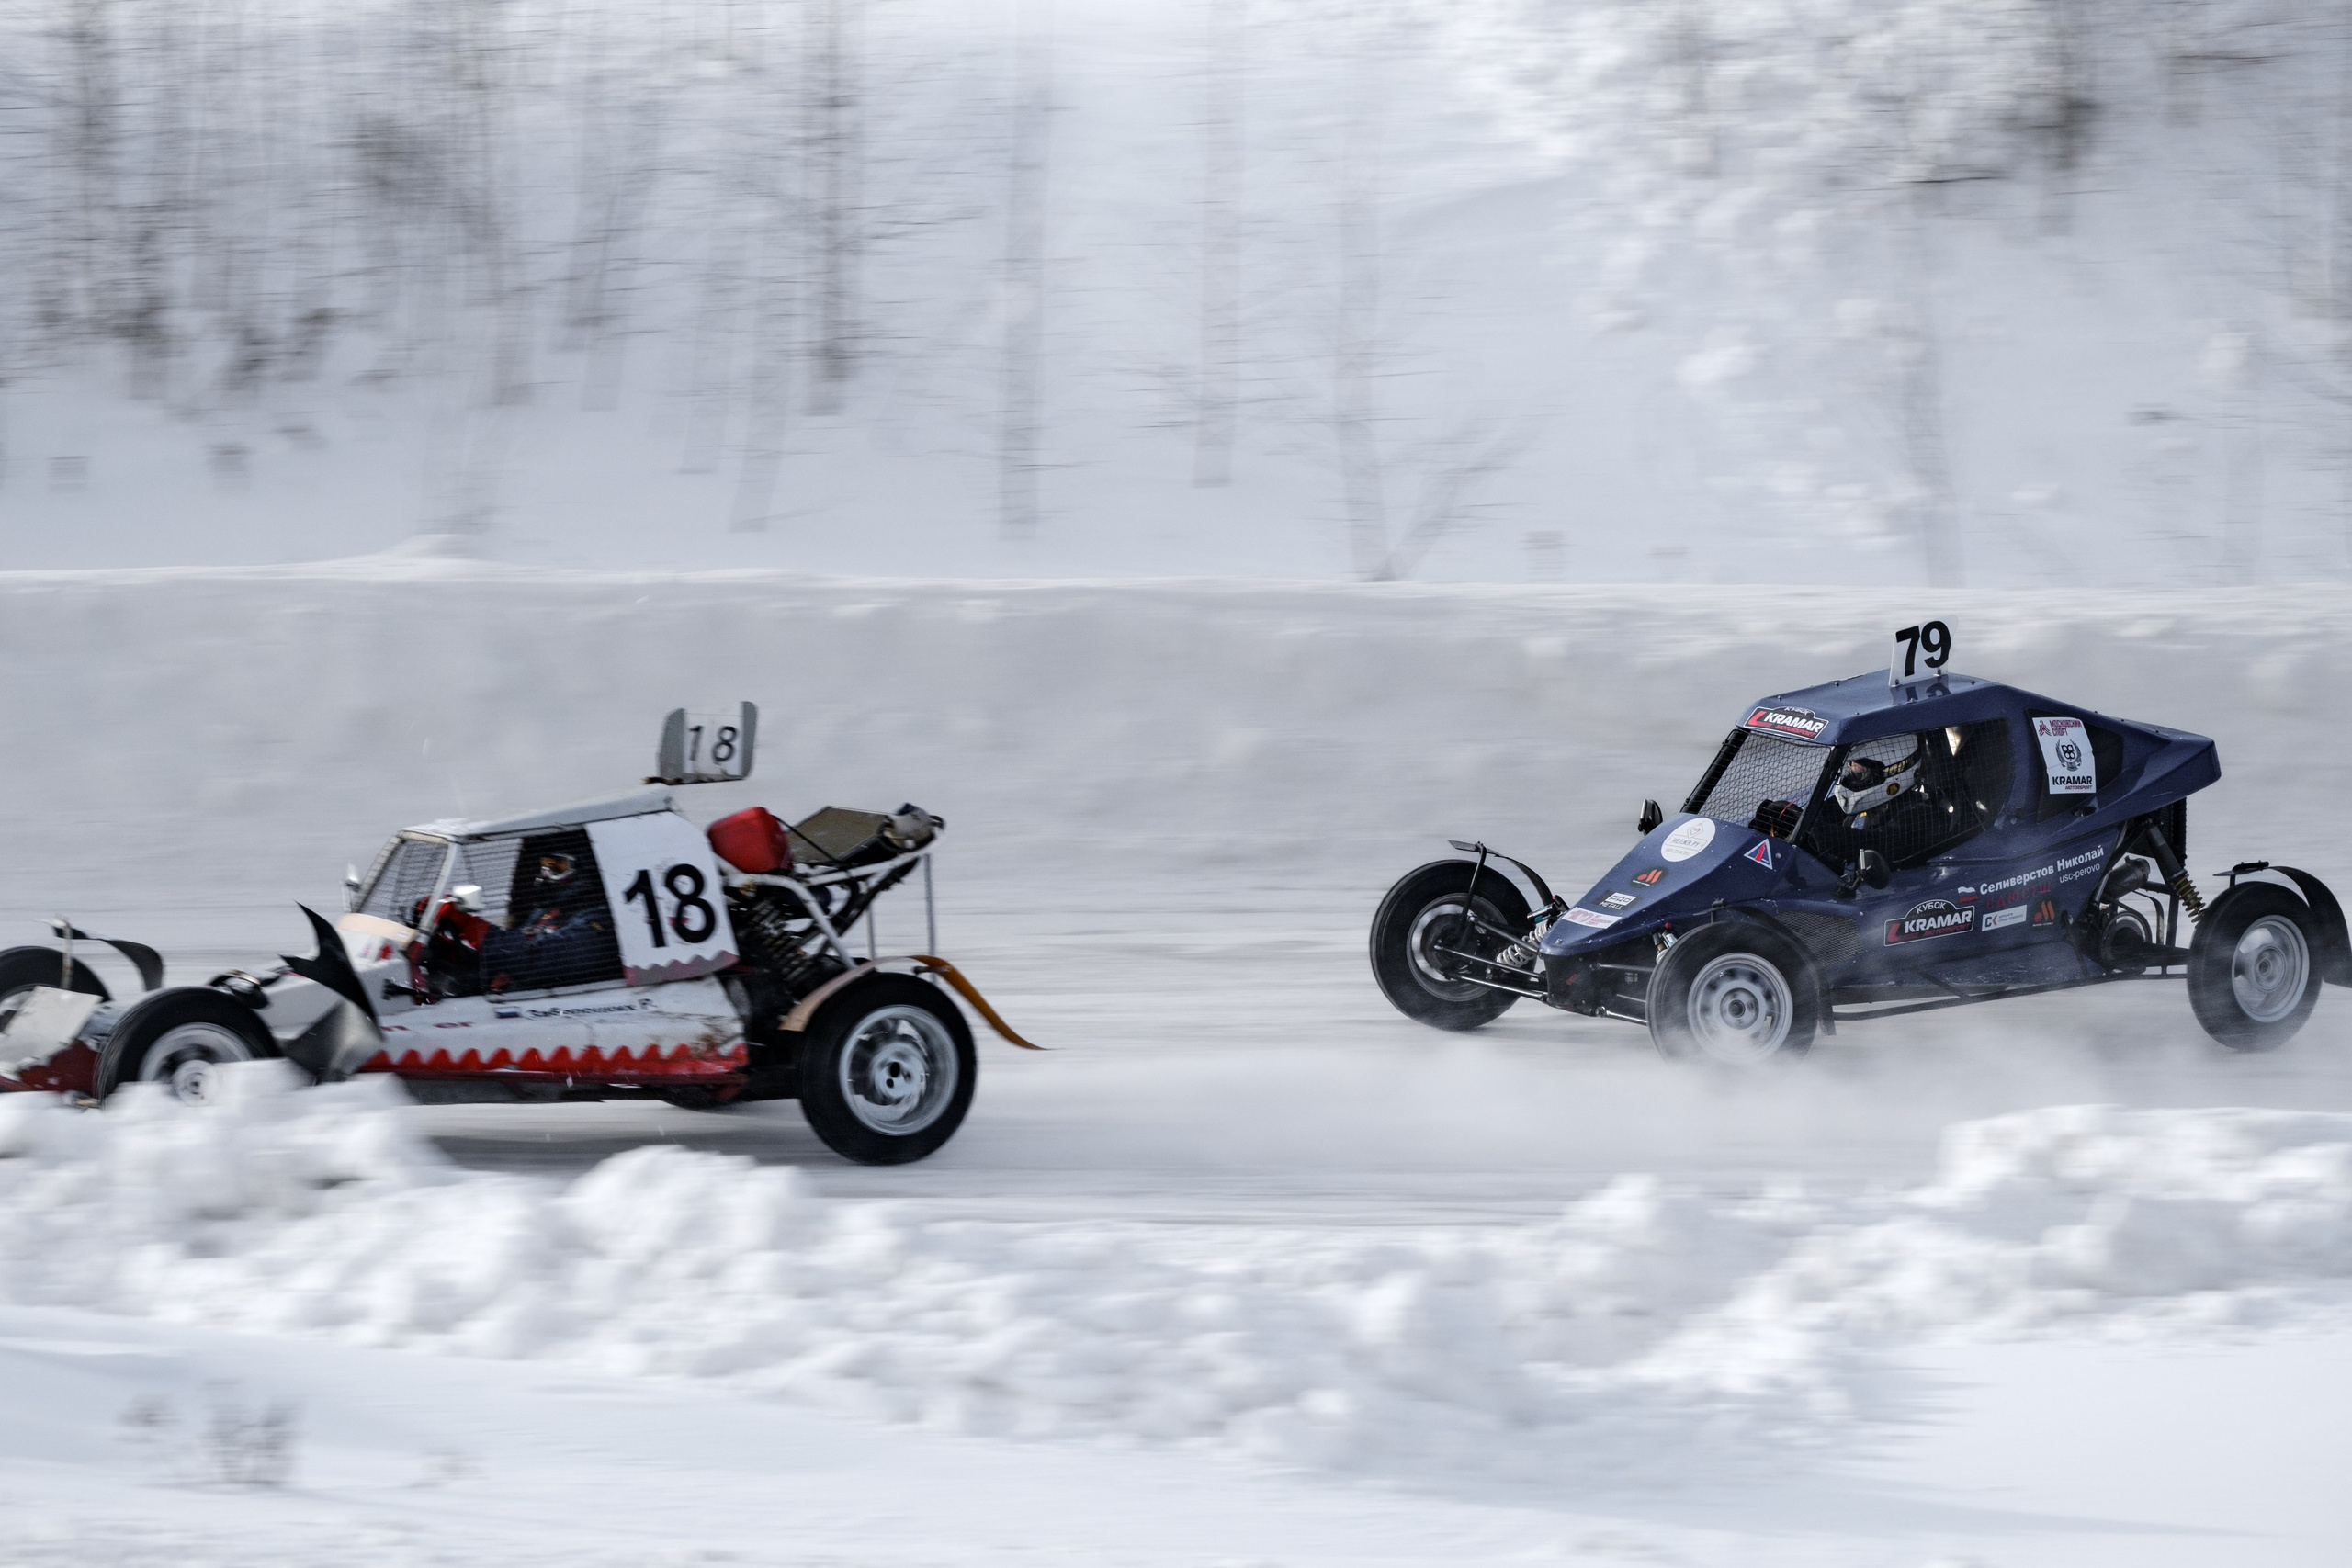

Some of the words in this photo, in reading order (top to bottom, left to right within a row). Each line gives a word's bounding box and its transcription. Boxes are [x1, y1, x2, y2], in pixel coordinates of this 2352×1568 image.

[1895, 620, 1951, 677] 79
[1763, 712, 1825, 733] KRAMAR
[687, 725, 738, 763] 18
[2052, 775, 2093, 786] KRAMAR
[1979, 864, 2054, 895] Селиверстов
[2056, 845, 2105, 872] Николай
[2059, 863, 2101, 884] usc-perovo
[622, 863, 717, 948] 18
[1599, 901, 1623, 910] METALL
[1610, 895, 1632, 904] PRO
[1916, 901, 1947, 914] КУБОК
[1904, 910, 1973, 934] KRAMAR
[1923, 922, 1972, 938] MOTORSPORT
